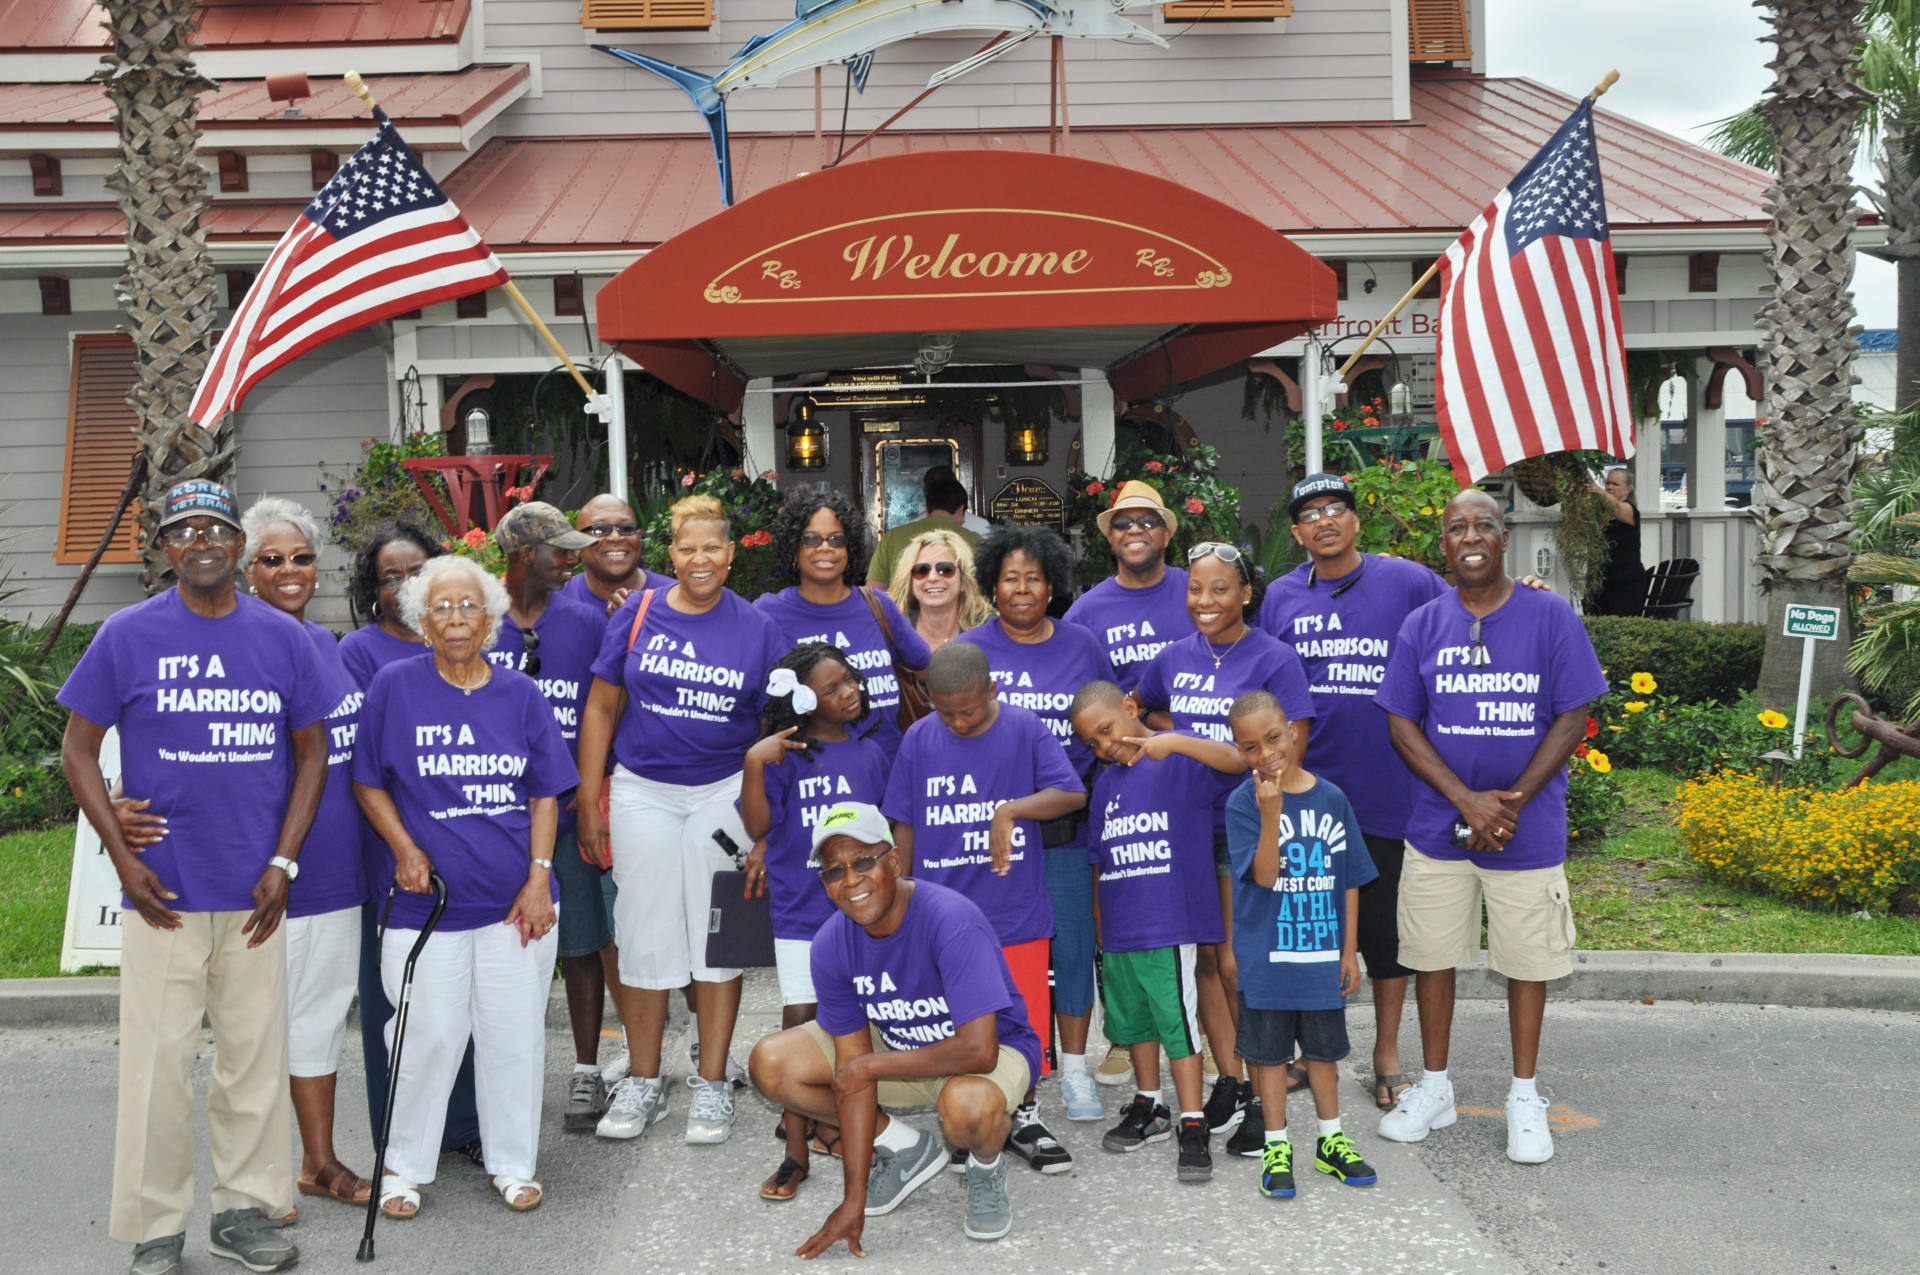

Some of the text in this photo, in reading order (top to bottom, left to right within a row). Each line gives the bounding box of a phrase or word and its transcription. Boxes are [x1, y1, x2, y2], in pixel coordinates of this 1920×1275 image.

[843, 233, 1093, 281] Welcome
[1136, 248, 1175, 277] RB's
[761, 260, 801, 289] RB's
[172, 483, 231, 499] KOREA
[171, 497, 232, 514] VETERAN
[1294, 612, 1343, 635] IT'S A
[1790, 609, 1836, 625] No Dogs
[1791, 622, 1831, 633] ALLOWED
[834, 631, 851, 649] A
[1106, 620, 1156, 645] IT'S A
[646, 633, 696, 659] IT'S A
[1109, 640, 1174, 667] HARR
[1295, 637, 1389, 658] HARRISON
[1436, 645, 1492, 667] IT'S A
[158, 654, 226, 680] IT'S A
[488, 651, 514, 670] T'S
[639, 653, 745, 691] HARRISON
[989, 670, 1033, 688] T'S A
[1173, 672, 1216, 692] IT'S A
[1327, 663, 1386, 684] THING
[1435, 672, 1541, 694] HARRISON
[156, 688, 282, 714] HARRISON
[676, 687, 737, 712] THING
[996, 691, 1075, 712] ARRISO
[1339, 685, 1378, 696] Understan
[652, 703, 690, 718] Wouldn't
[1169, 695, 1235, 717] HARRISO
[1476, 701, 1536, 722] THING
[208, 722, 276, 746] THING
[416, 724, 476, 746] IT'S A
[1191, 722, 1234, 743] THIN
[1437, 724, 1536, 737] You Wouldn't Understand
[158, 748, 274, 763] You Wouldn't Understand
[417, 753, 528, 777] HARRISON
[462, 782, 517, 805] THIN
[798, 774, 852, 799] IT'S A
[926, 773, 978, 798] IT'S A
[446, 804, 484, 818] Wouldn
[926, 799, 1015, 826] HARRIS
[962, 826, 1026, 852] THG
[1300, 809, 1347, 854] NAVY
[923, 858, 940, 869] You
[940, 855, 976, 868] Wouldn't
[1110, 839, 1172, 866] THING
[1287, 841, 1326, 878] 94
[1126, 863, 1171, 878] Understand
[1272, 877, 1305, 893] WEST
[1277, 891, 1338, 922] ATHL
[1276, 921, 1339, 951] DEPT
[880, 971, 897, 993] A
